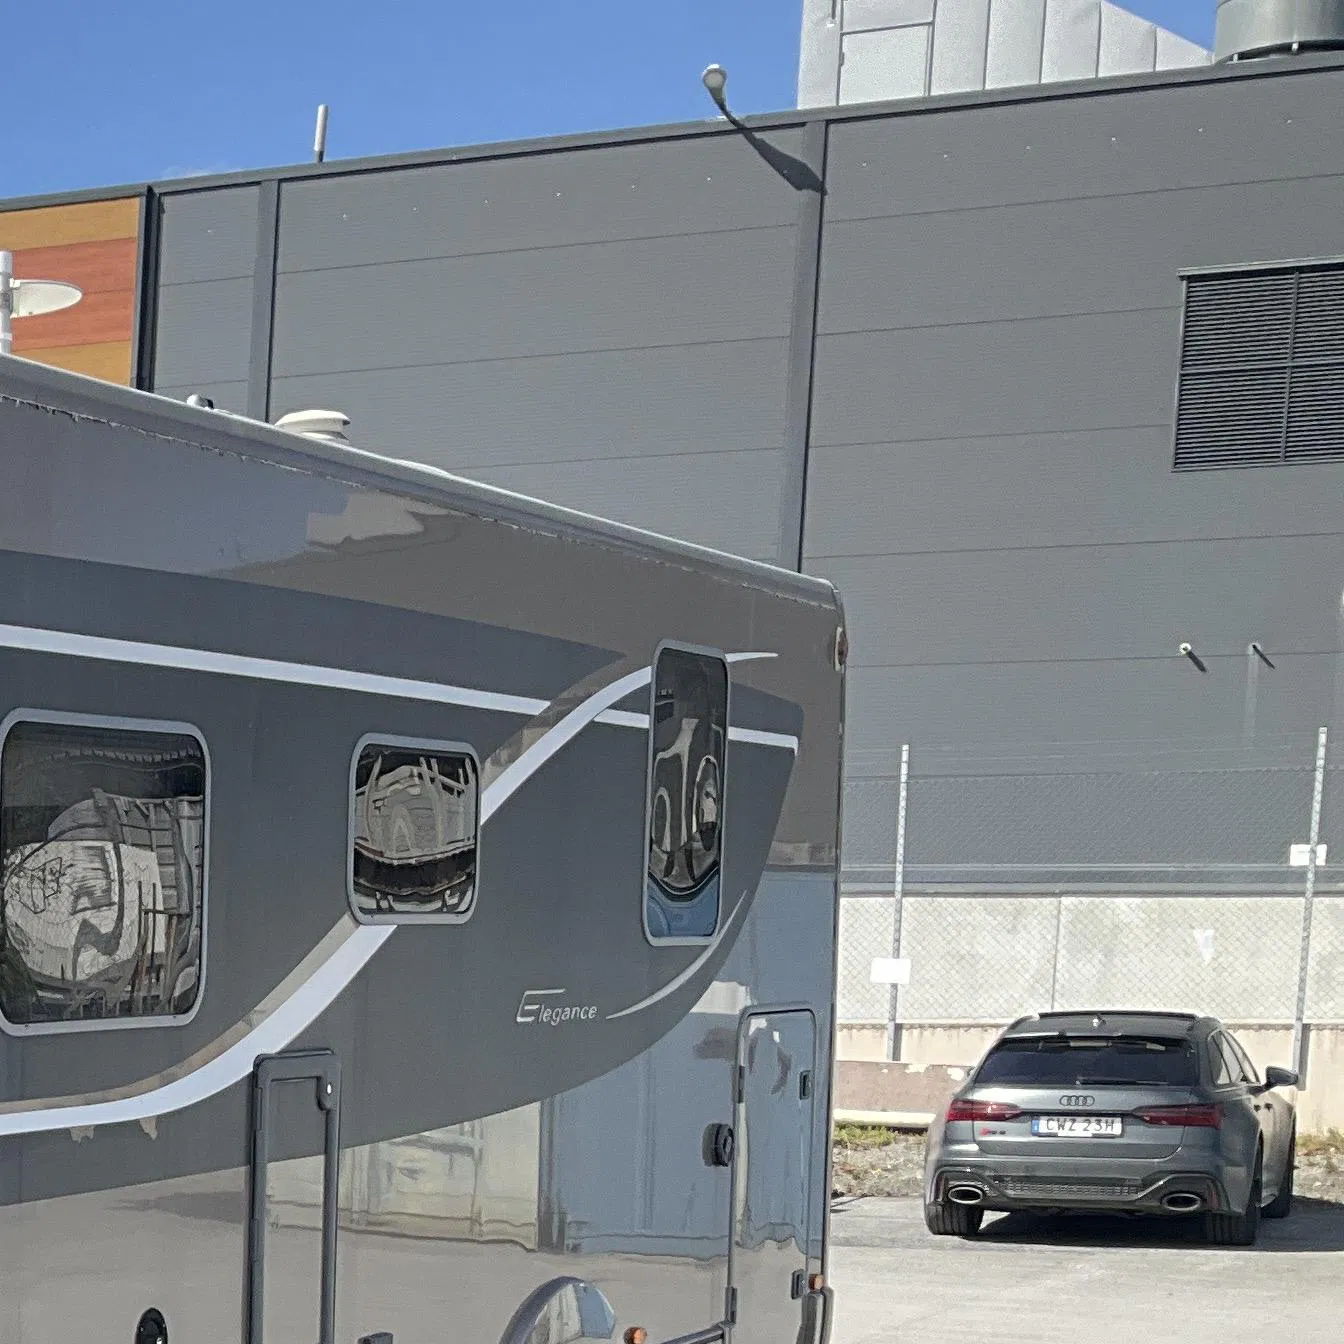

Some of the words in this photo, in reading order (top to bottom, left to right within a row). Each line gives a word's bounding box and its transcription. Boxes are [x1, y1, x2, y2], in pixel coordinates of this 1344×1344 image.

[517, 988, 597, 1026] Elegance
[1046, 1117, 1076, 1132] CWZ
[1082, 1118, 1115, 1132] 23H
